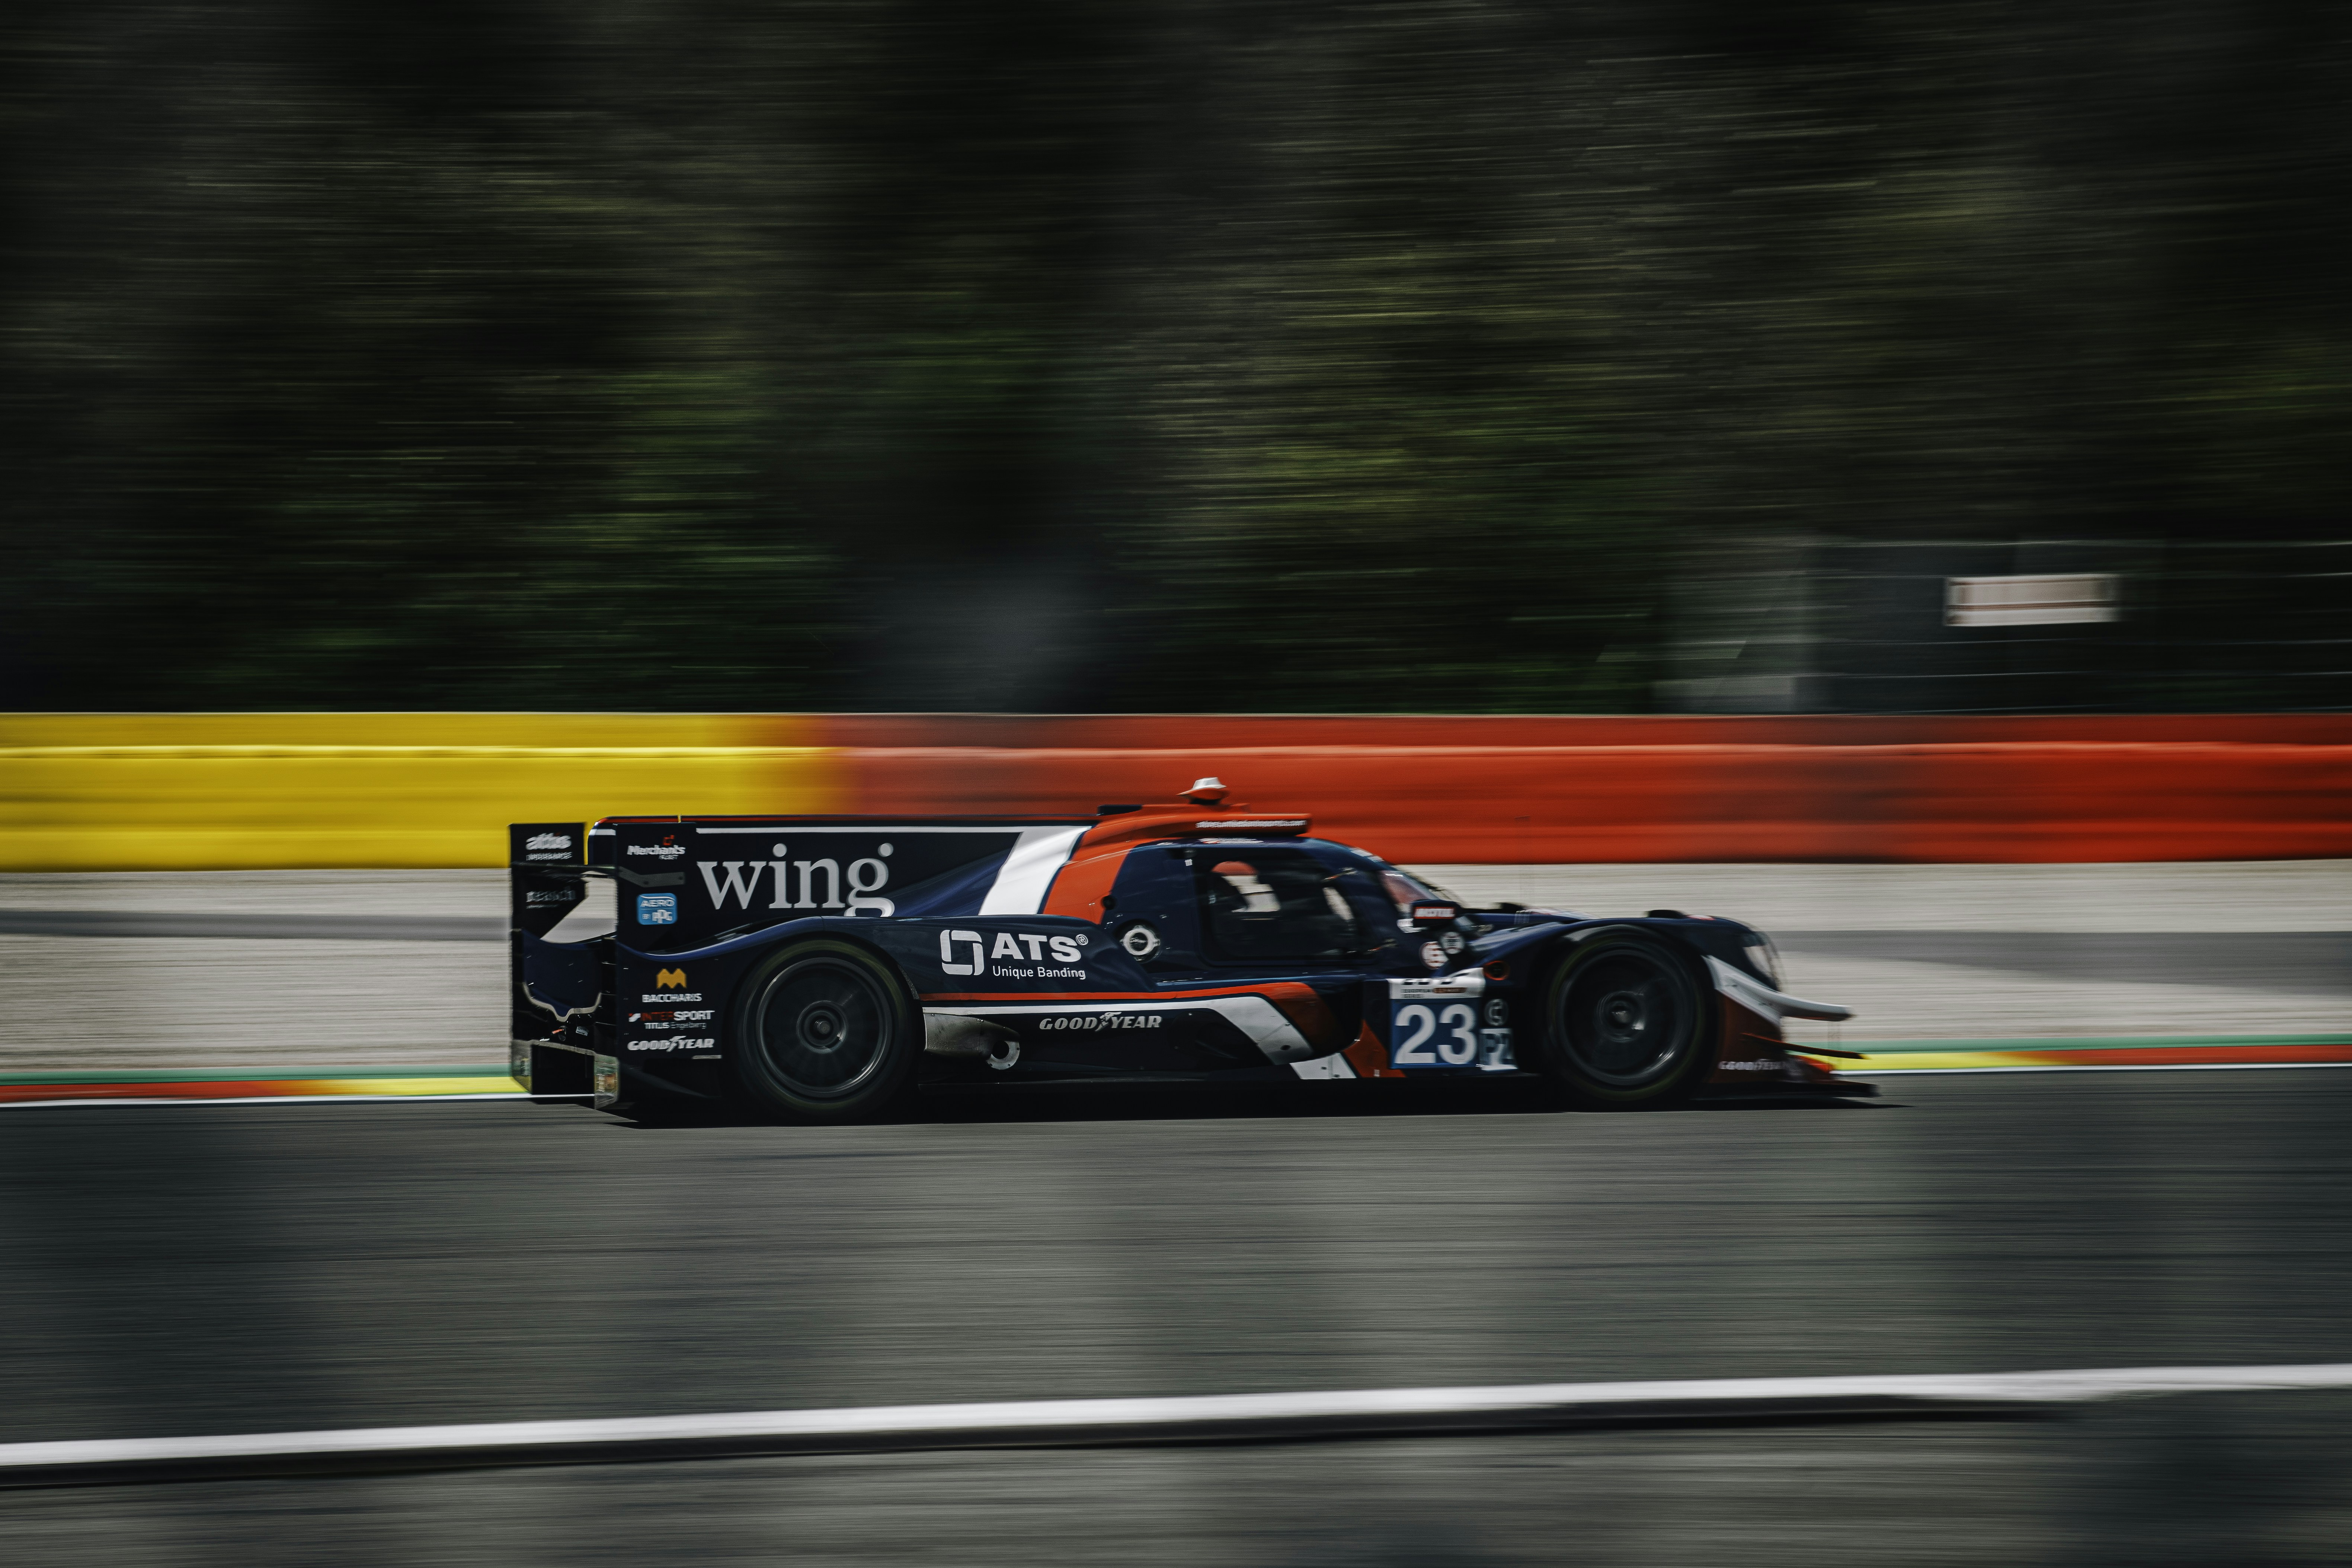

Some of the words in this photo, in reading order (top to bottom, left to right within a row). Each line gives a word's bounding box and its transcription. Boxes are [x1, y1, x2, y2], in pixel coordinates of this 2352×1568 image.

[627, 845, 686, 855] Merchants
[697, 842, 895, 917] wing
[993, 966, 1033, 979] Unique
[1037, 967, 1086, 980] Banding
[642, 993, 702, 1002] BACCHARIS
[1039, 1013, 1163, 1031] GOODYEAR
[1395, 1004, 1477, 1064] 23
[627, 1037, 714, 1052] GOODYEAR
